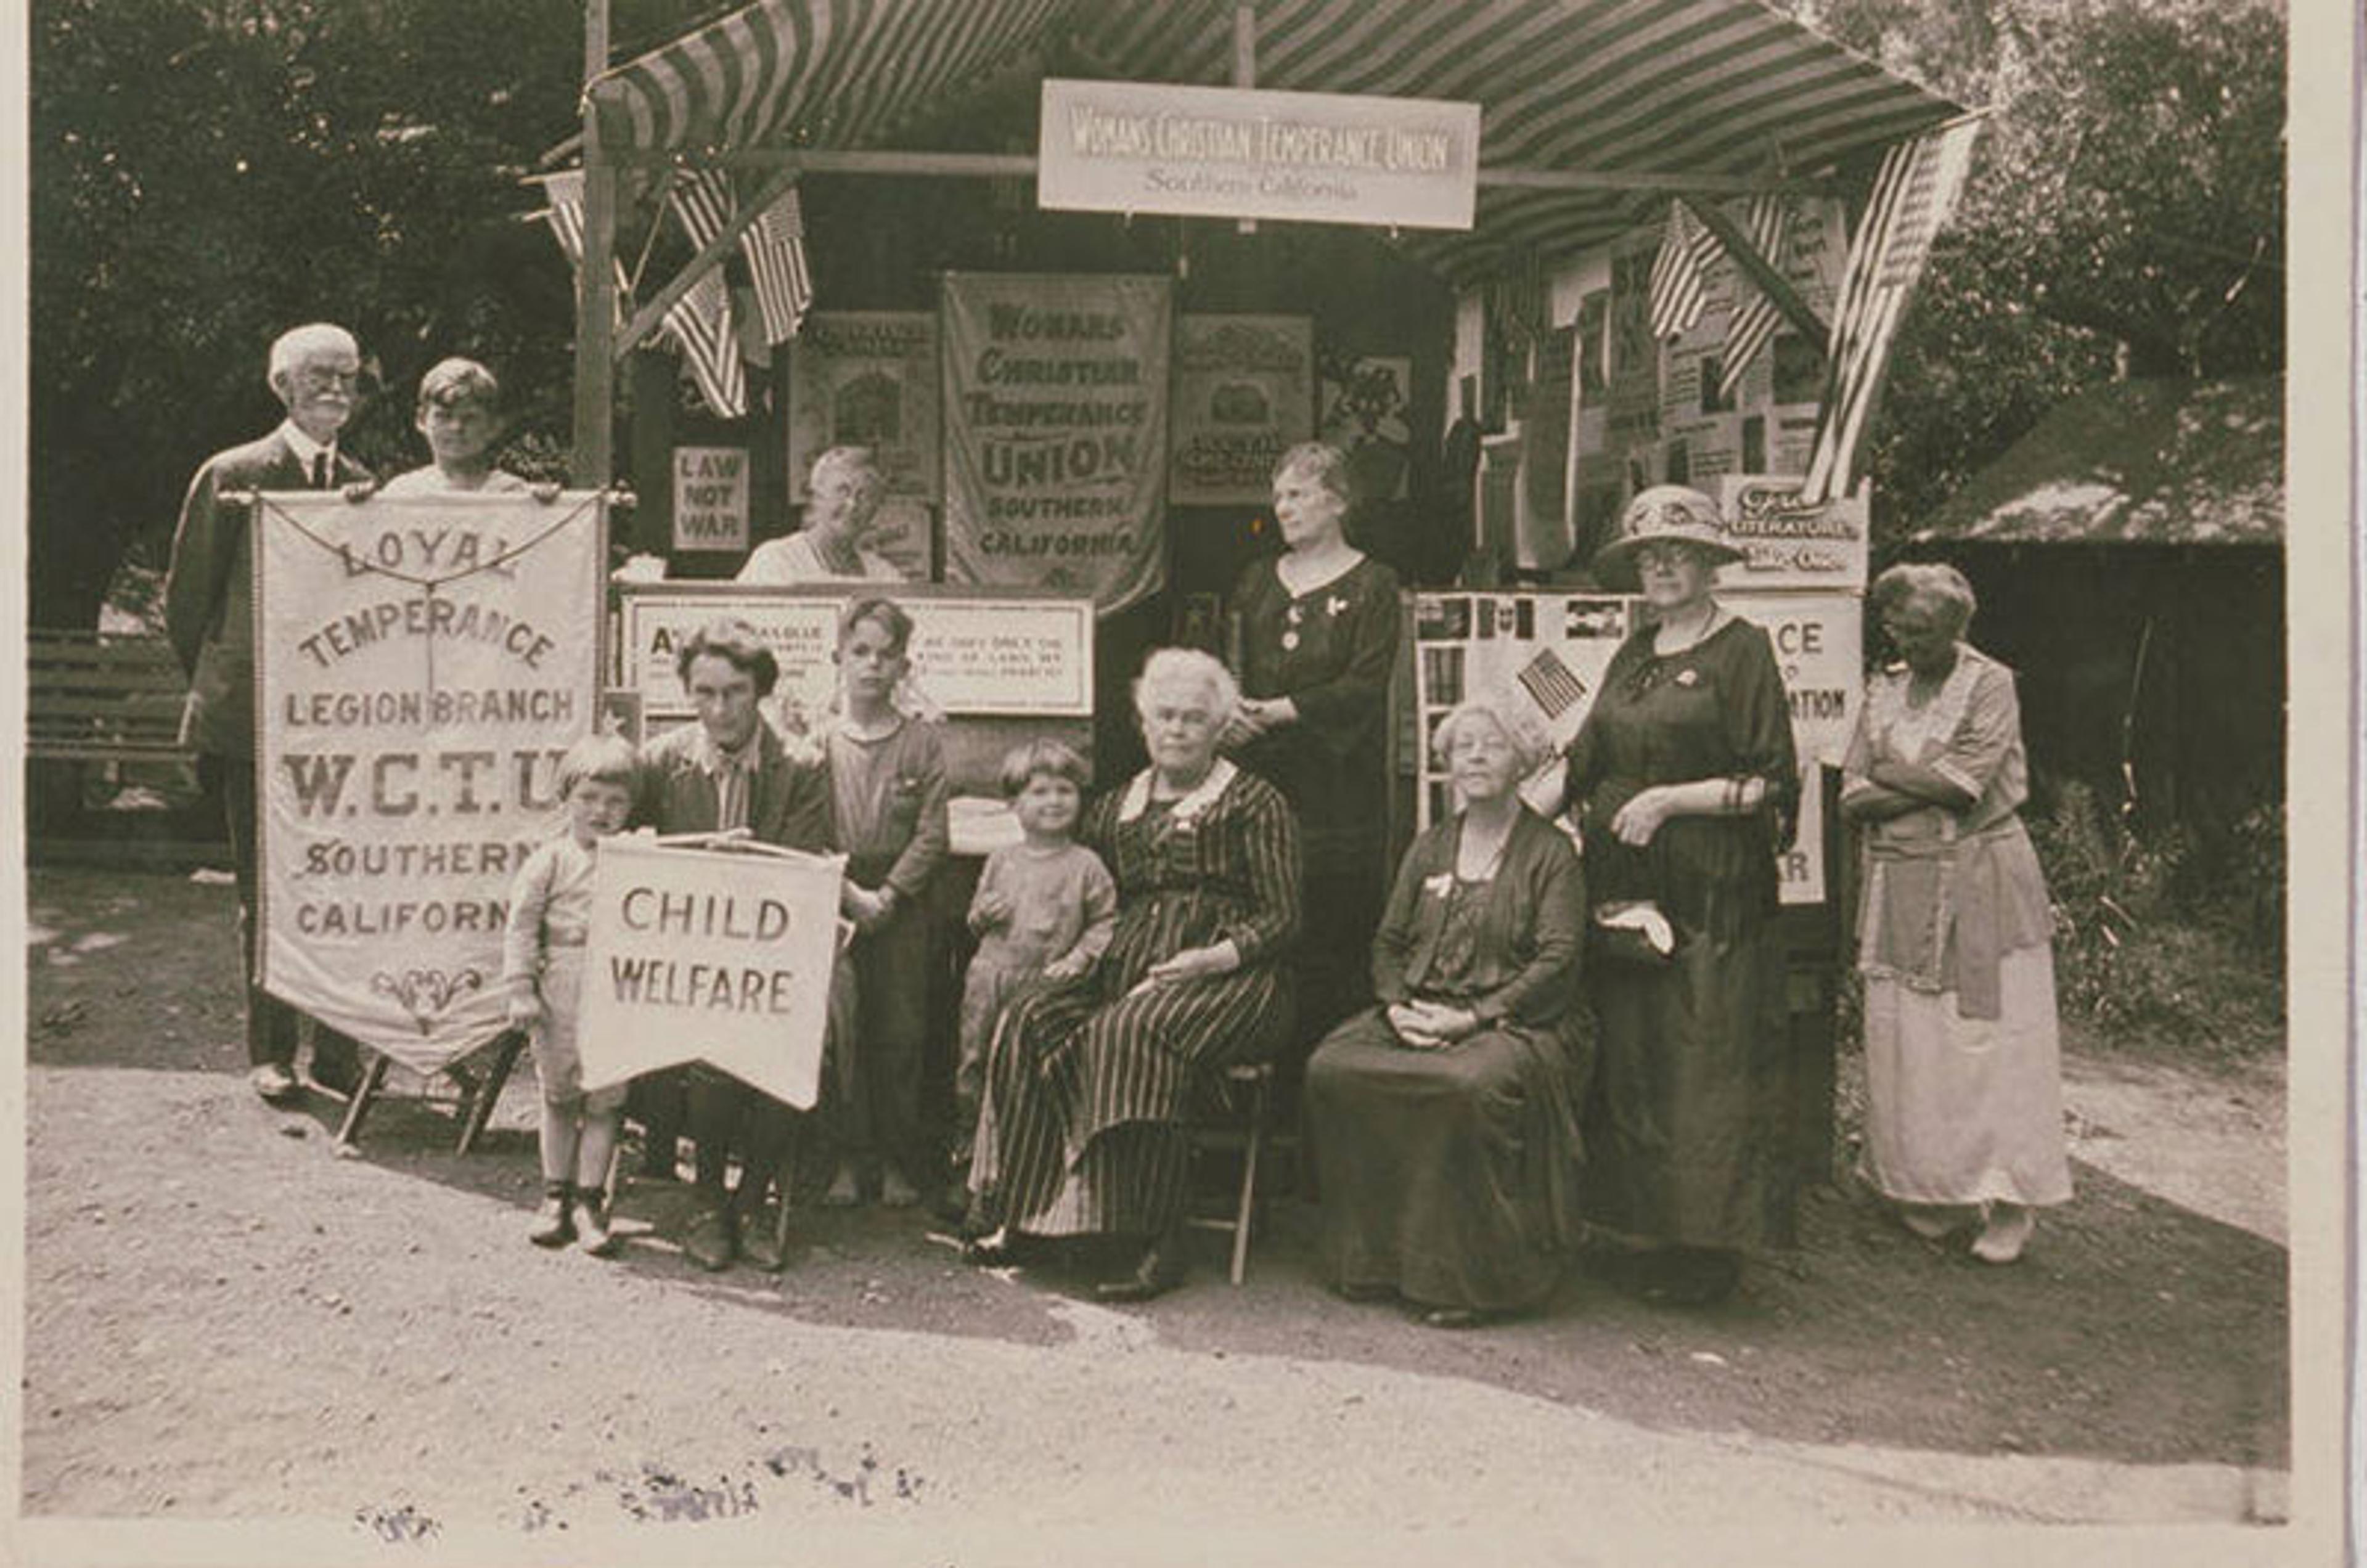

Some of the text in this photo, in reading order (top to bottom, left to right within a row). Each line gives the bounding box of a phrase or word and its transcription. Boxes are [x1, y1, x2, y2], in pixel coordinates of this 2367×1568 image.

[977, 347, 1139, 386] CHRISTIAN
[965, 391, 1149, 427] TEMPERANCE
[680, 454, 740, 478] LAW
[983, 435, 1135, 489] UNION
[682, 484, 734, 507] NOT
[987, 497, 1124, 519] SOUTHERN
[680, 513, 739, 540] WAR
[979, 530, 1137, 556] CALIFORNIA
[338, 526, 518, 579] LOYAL
[298, 595, 555, 670] TEMPERANCE
[1777, 622, 1823, 655] CE
[285, 688, 574, 727] LEGION BRANCH
[1789, 688, 1847, 721] ATION
[1786, 851, 1810, 883] R
[296, 900, 510, 934] CALIFORN
[621, 886, 791, 941] CHILD
[610, 956, 794, 1014] WELFARE
